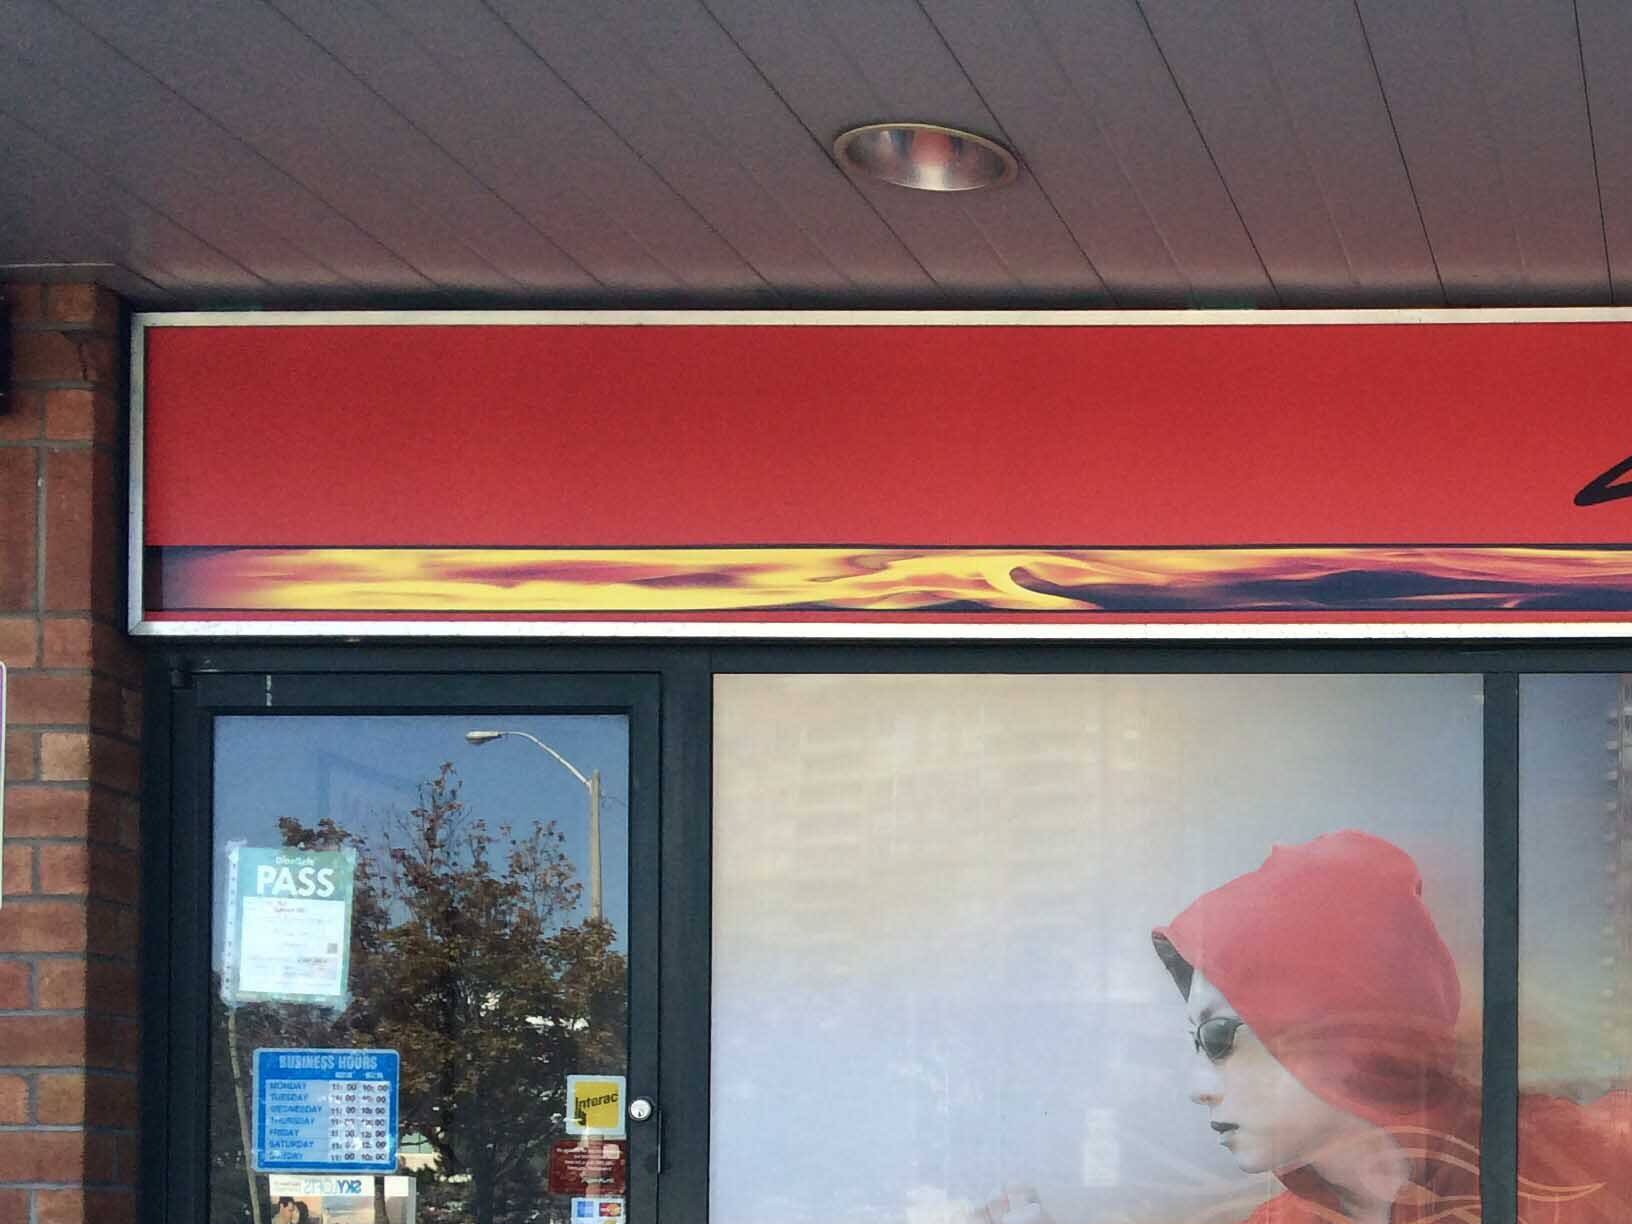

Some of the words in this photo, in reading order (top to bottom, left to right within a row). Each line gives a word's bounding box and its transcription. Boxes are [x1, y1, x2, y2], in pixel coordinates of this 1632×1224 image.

[256, 864, 336, 898] PASS
[279, 1055, 335, 1069] BUSINESS
[338, 1055, 378, 1070] HOURS
[575, 1092, 619, 1111] Interac
